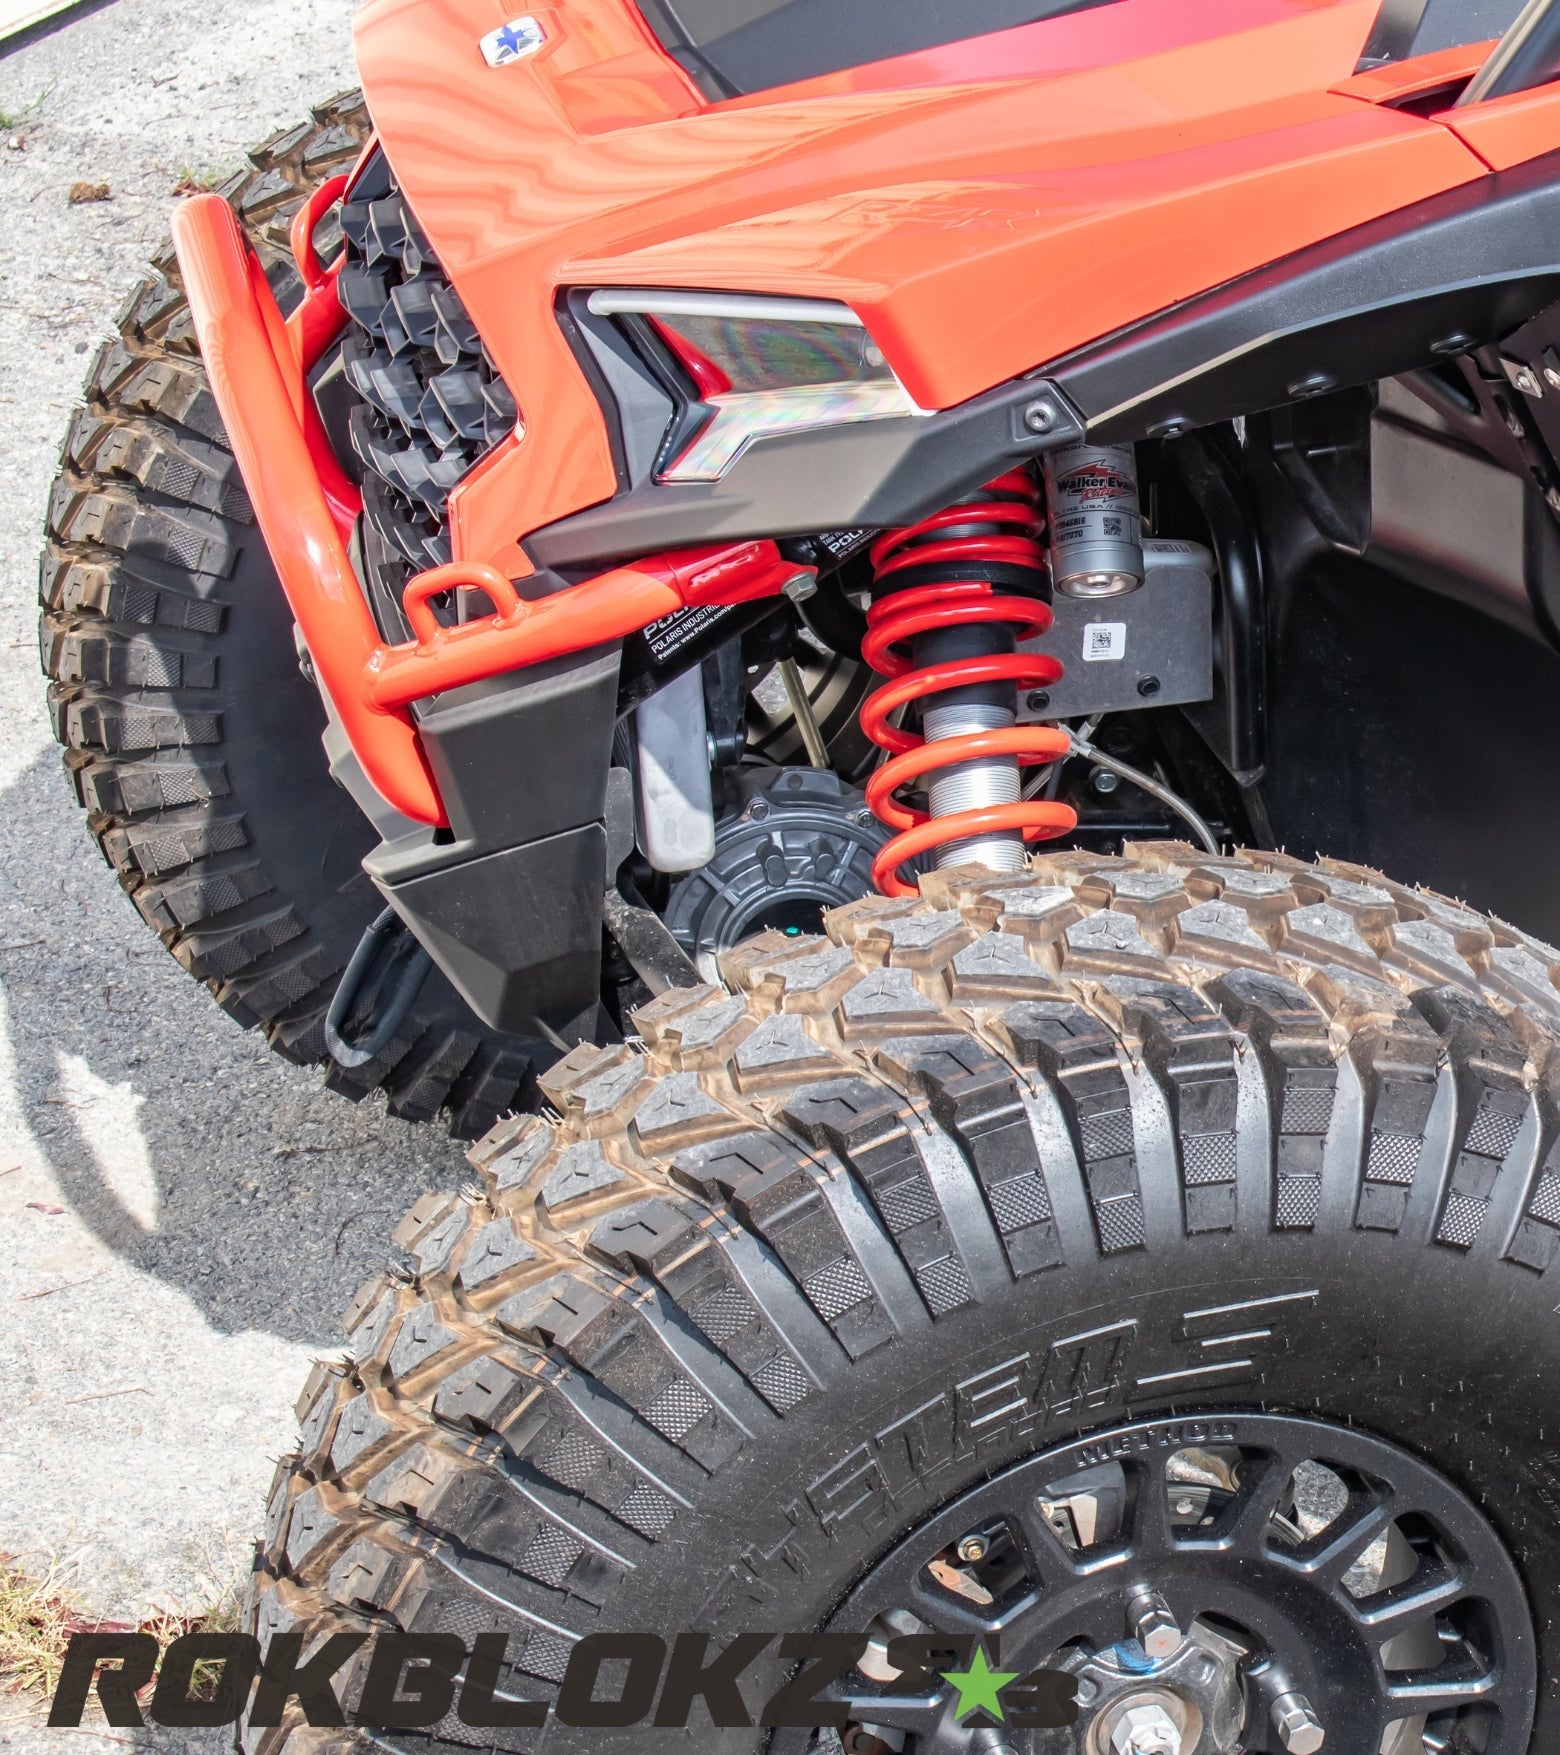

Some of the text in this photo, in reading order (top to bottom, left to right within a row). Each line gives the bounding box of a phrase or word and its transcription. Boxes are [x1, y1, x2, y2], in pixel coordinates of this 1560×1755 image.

[1058, 476, 1106, 492] Walker
[651, 627, 684, 653] POLARIS
[657, 641, 682, 661] Patents:
[1074, 1422, 1238, 1468] METHOD
